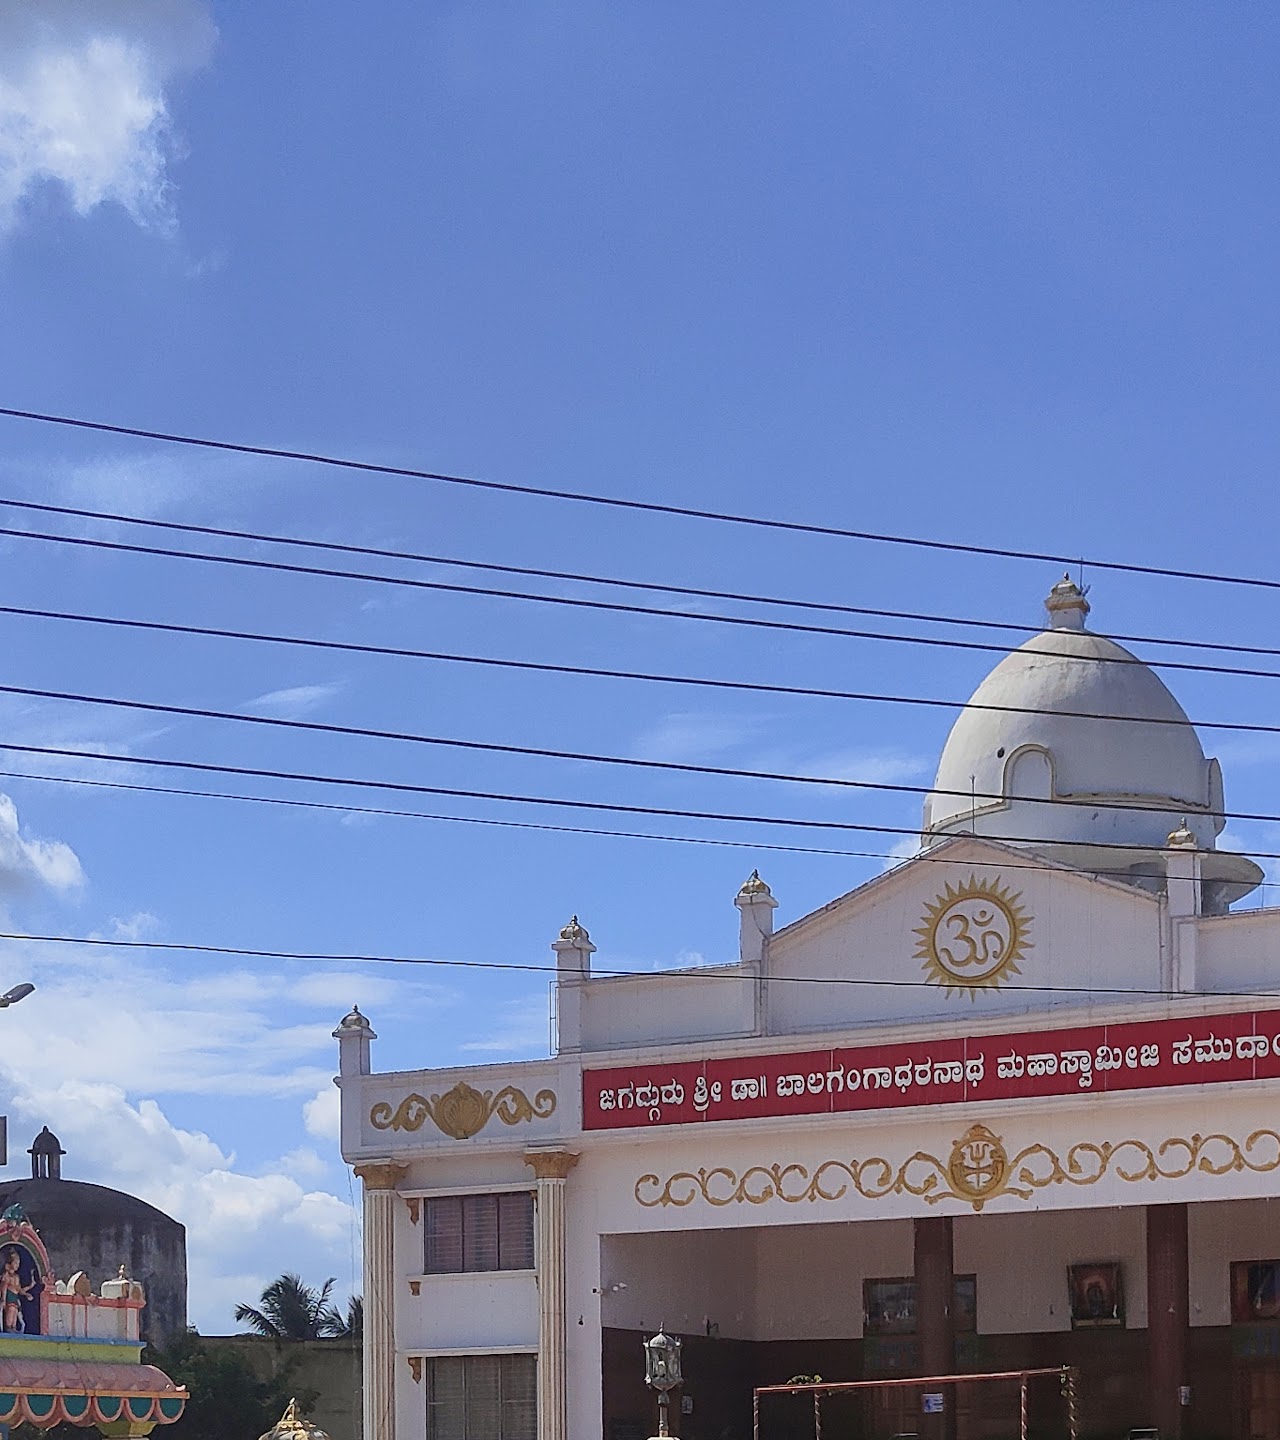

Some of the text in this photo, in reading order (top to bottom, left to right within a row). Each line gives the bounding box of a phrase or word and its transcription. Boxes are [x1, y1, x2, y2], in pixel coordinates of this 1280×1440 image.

[600, 1078, 685, 1121] ಜಗದ್ಗುರು
[693, 1077, 722, 1111] ಶ್ರೀ
[777, 1052, 985, 1097] ಬಾಲಗಂಗಾಧರನಾಥ
[997, 1044, 1160, 1088] ಮಹಾಸ್ವಾಮೀಜಿ
